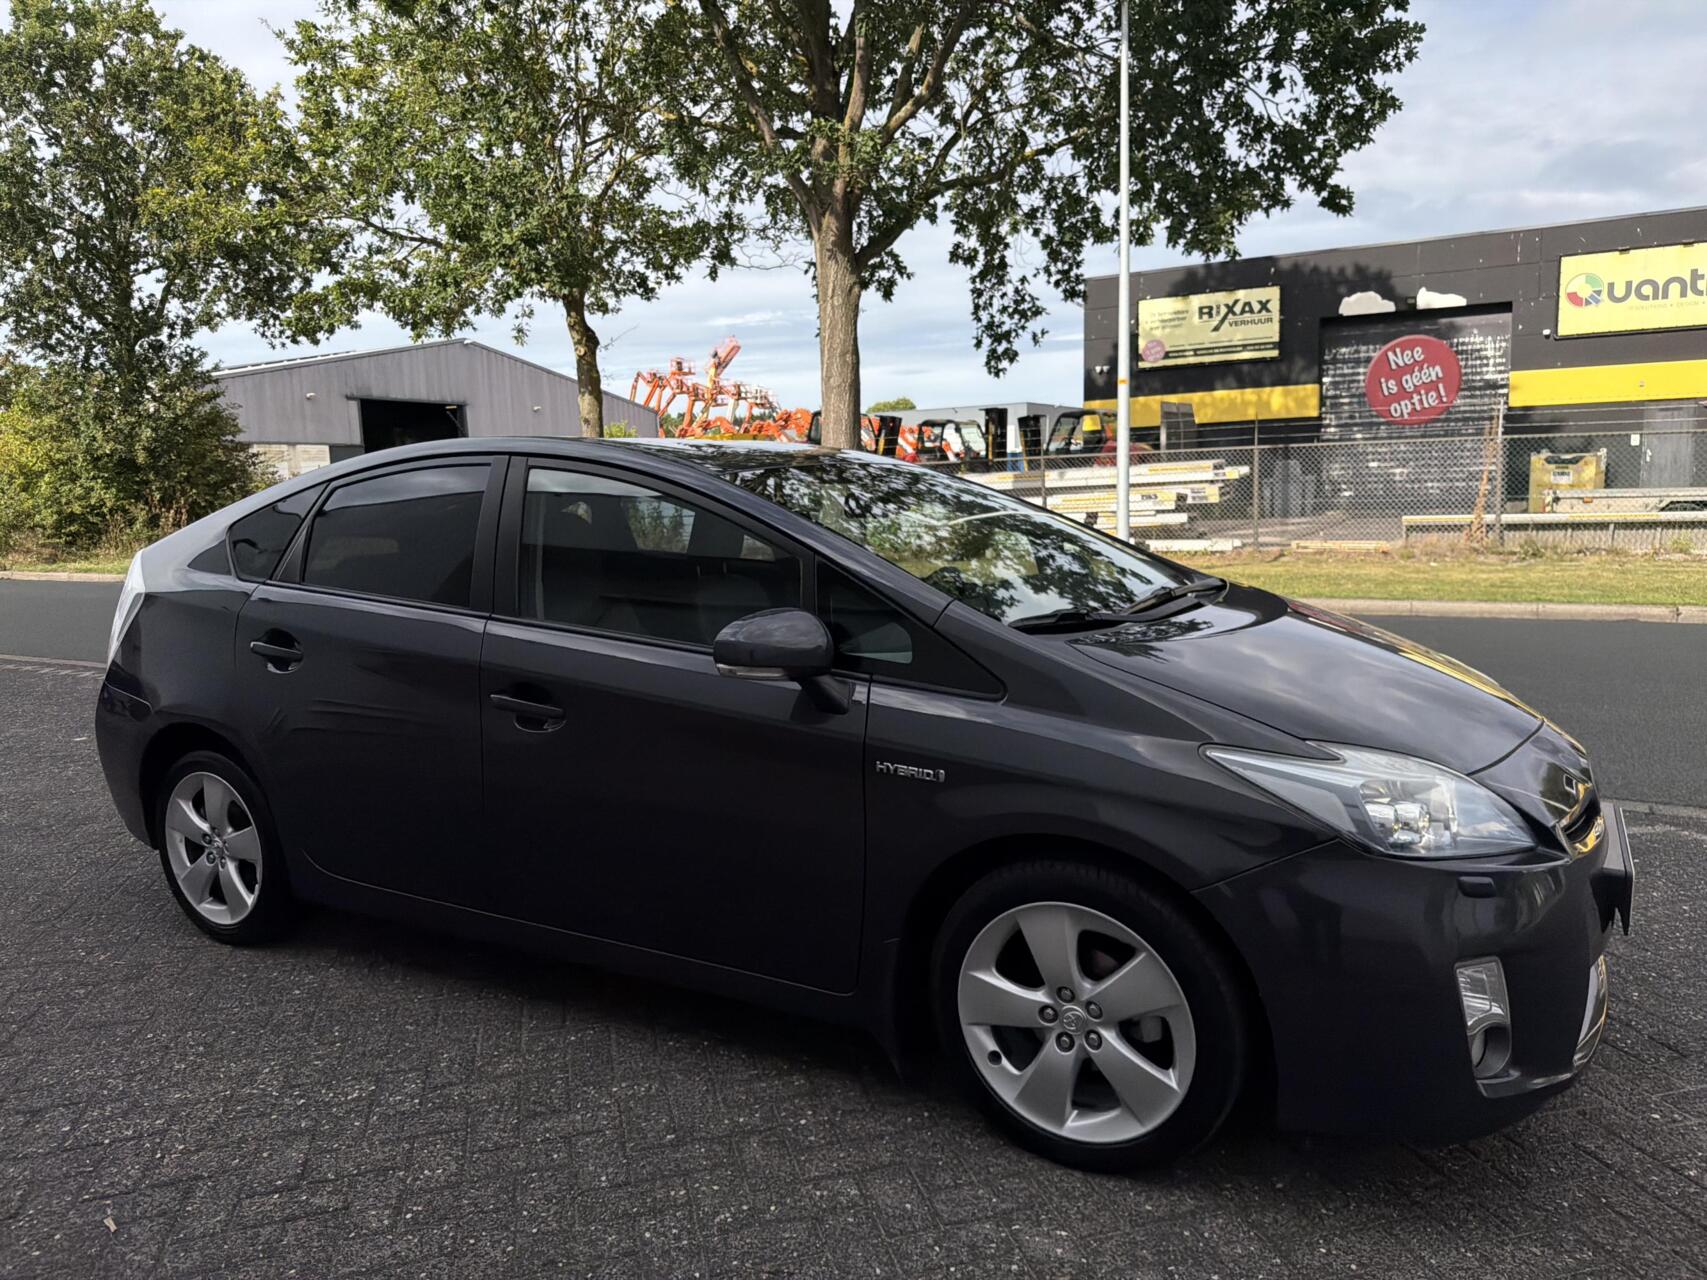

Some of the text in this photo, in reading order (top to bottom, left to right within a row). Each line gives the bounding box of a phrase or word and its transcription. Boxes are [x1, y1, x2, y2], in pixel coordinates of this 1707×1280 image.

[1565, 268, 1707, 308] Quant
[1228, 317, 1273, 327] VERHUUR
[1387, 347, 1425, 370] Nee
[1380, 364, 1443, 396] is géén
[876, 761, 935, 781] HYBRID
